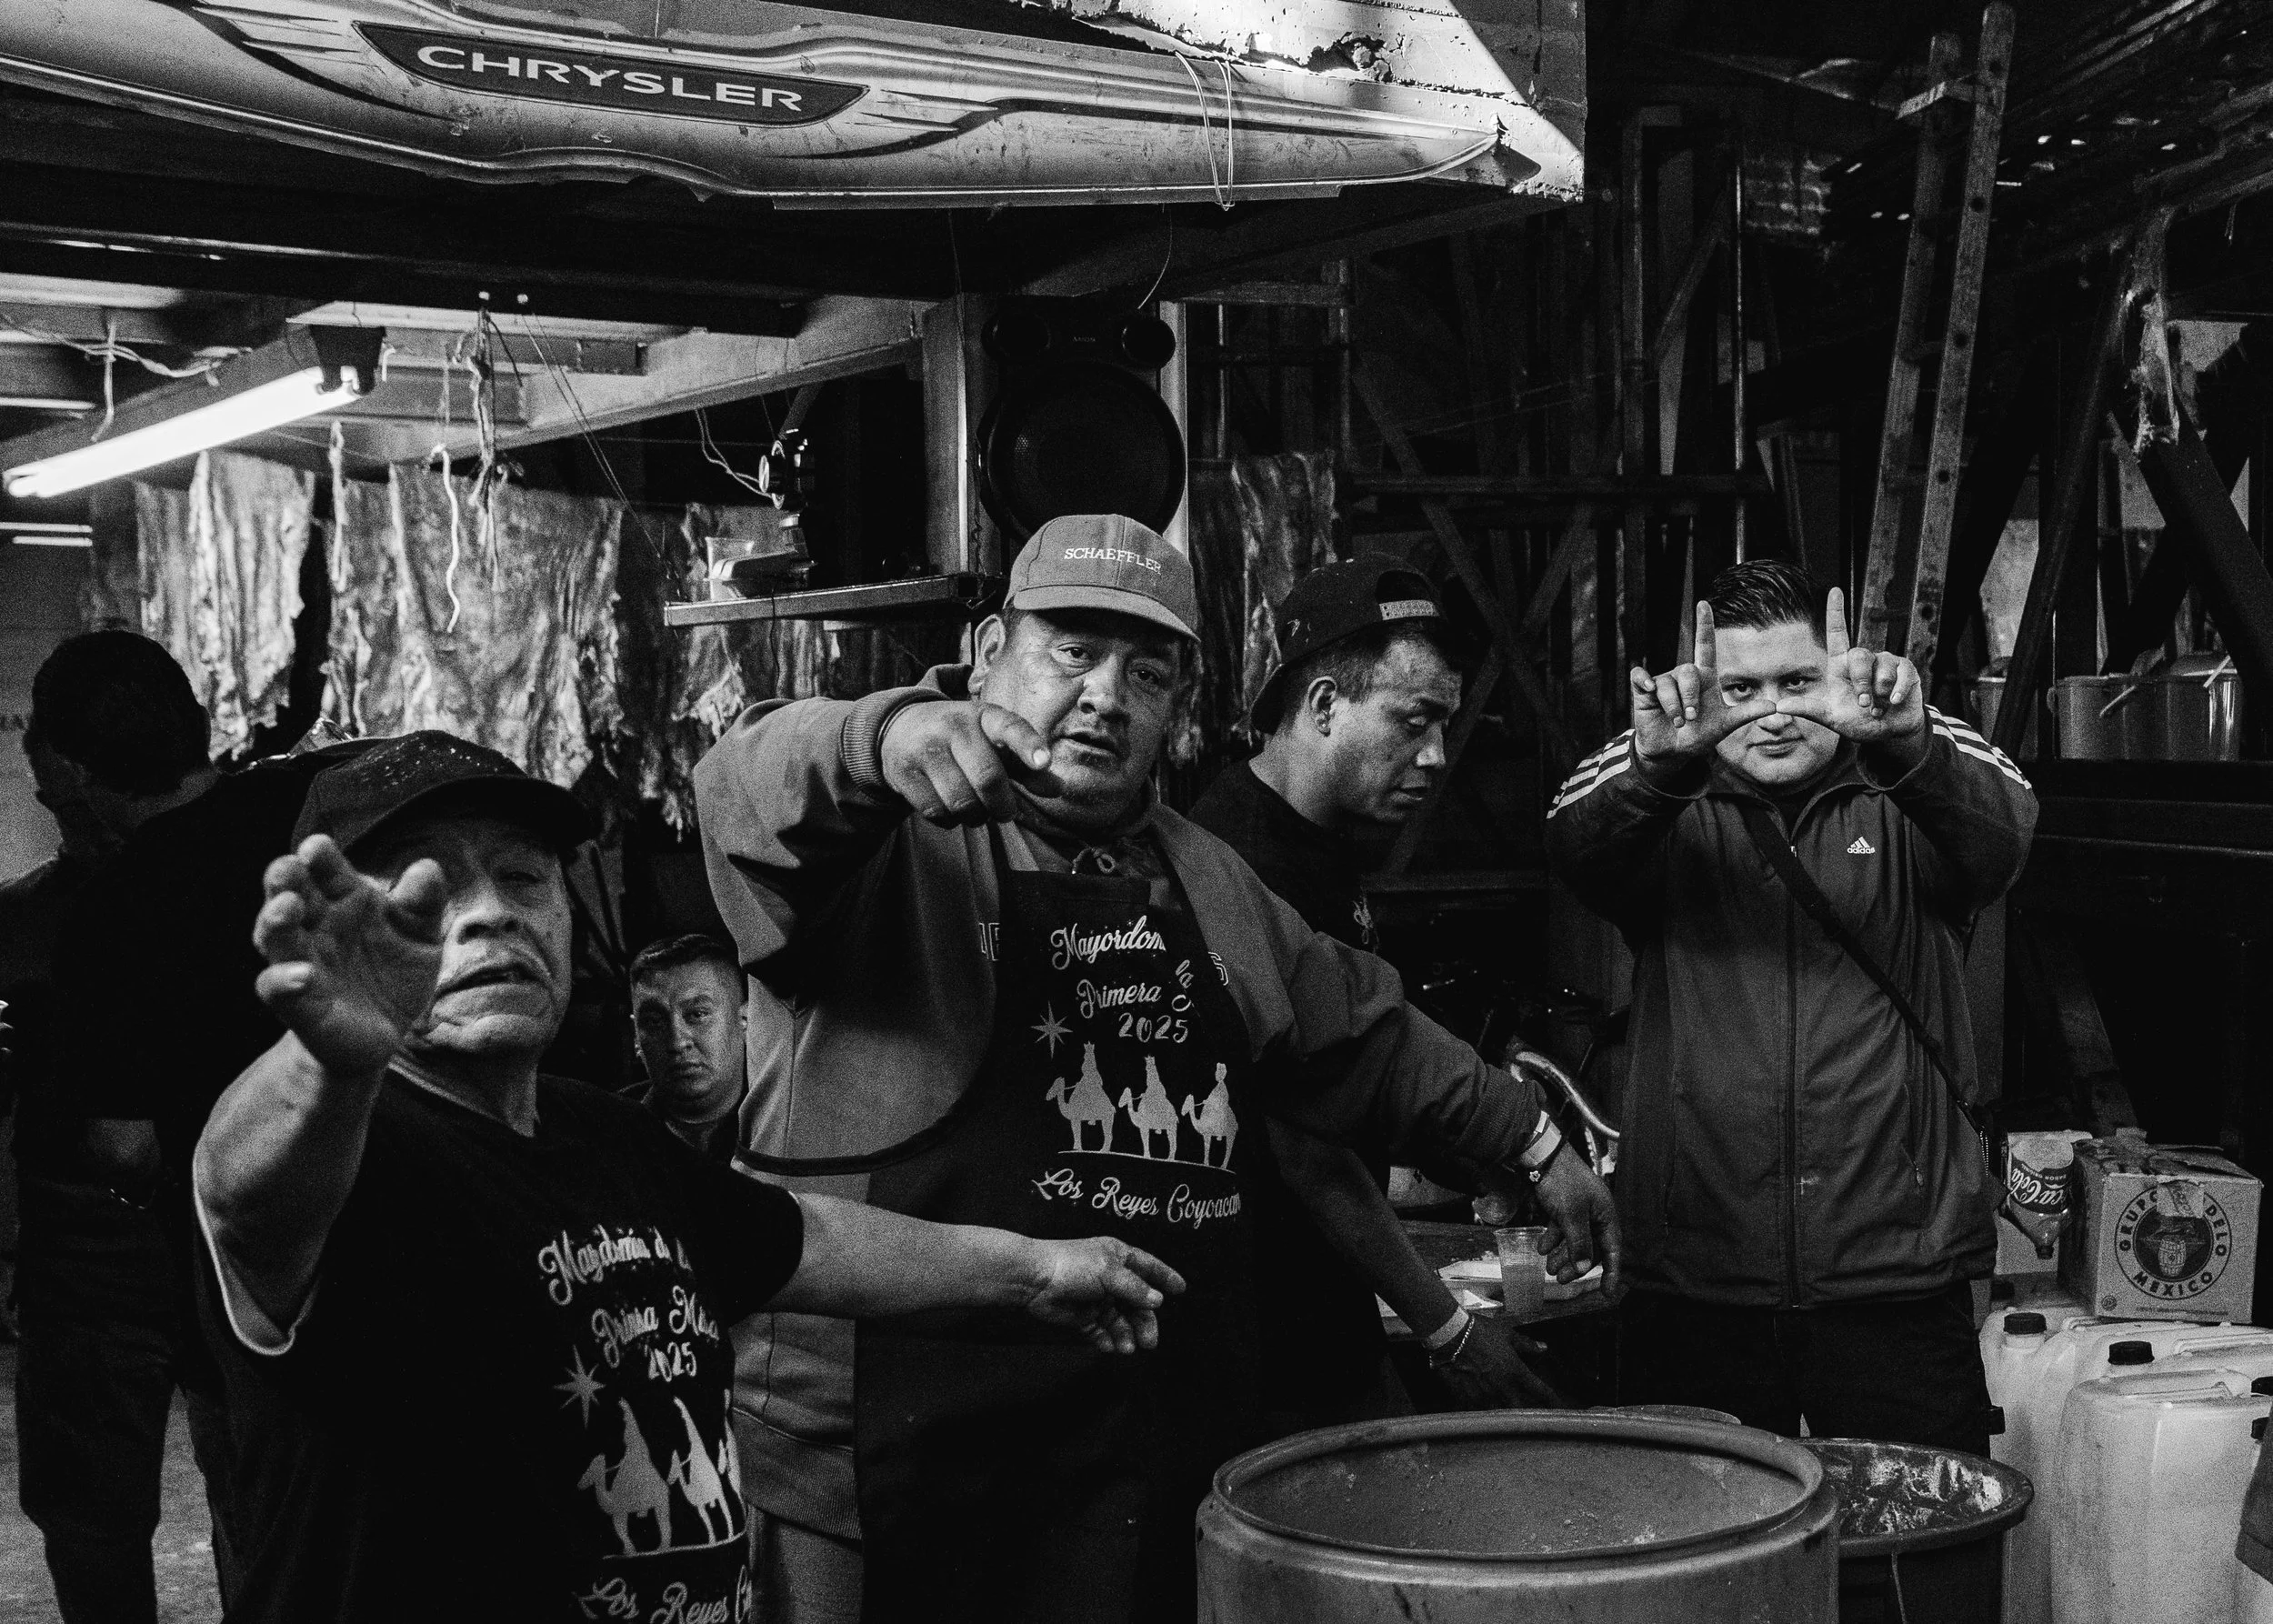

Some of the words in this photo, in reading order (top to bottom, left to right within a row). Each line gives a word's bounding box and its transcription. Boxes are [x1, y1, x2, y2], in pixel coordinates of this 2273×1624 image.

[417, 45, 803, 112] CHRYSLER
[1064, 547, 1161, 576] SCHAEFFLER
[1076, 978, 1162, 1019] Primera
[1118, 1012, 1189, 1043] 2025
[1031, 1168, 1083, 1199] Los
[1092, 1177, 1159, 1220] Reyes
[2134, 1271, 2214, 1297] MEXICO
[645, 1341, 697, 1382] 2025
[572, 1577, 640, 1620] Los
[649, 1581, 729, 1624] Reyes
